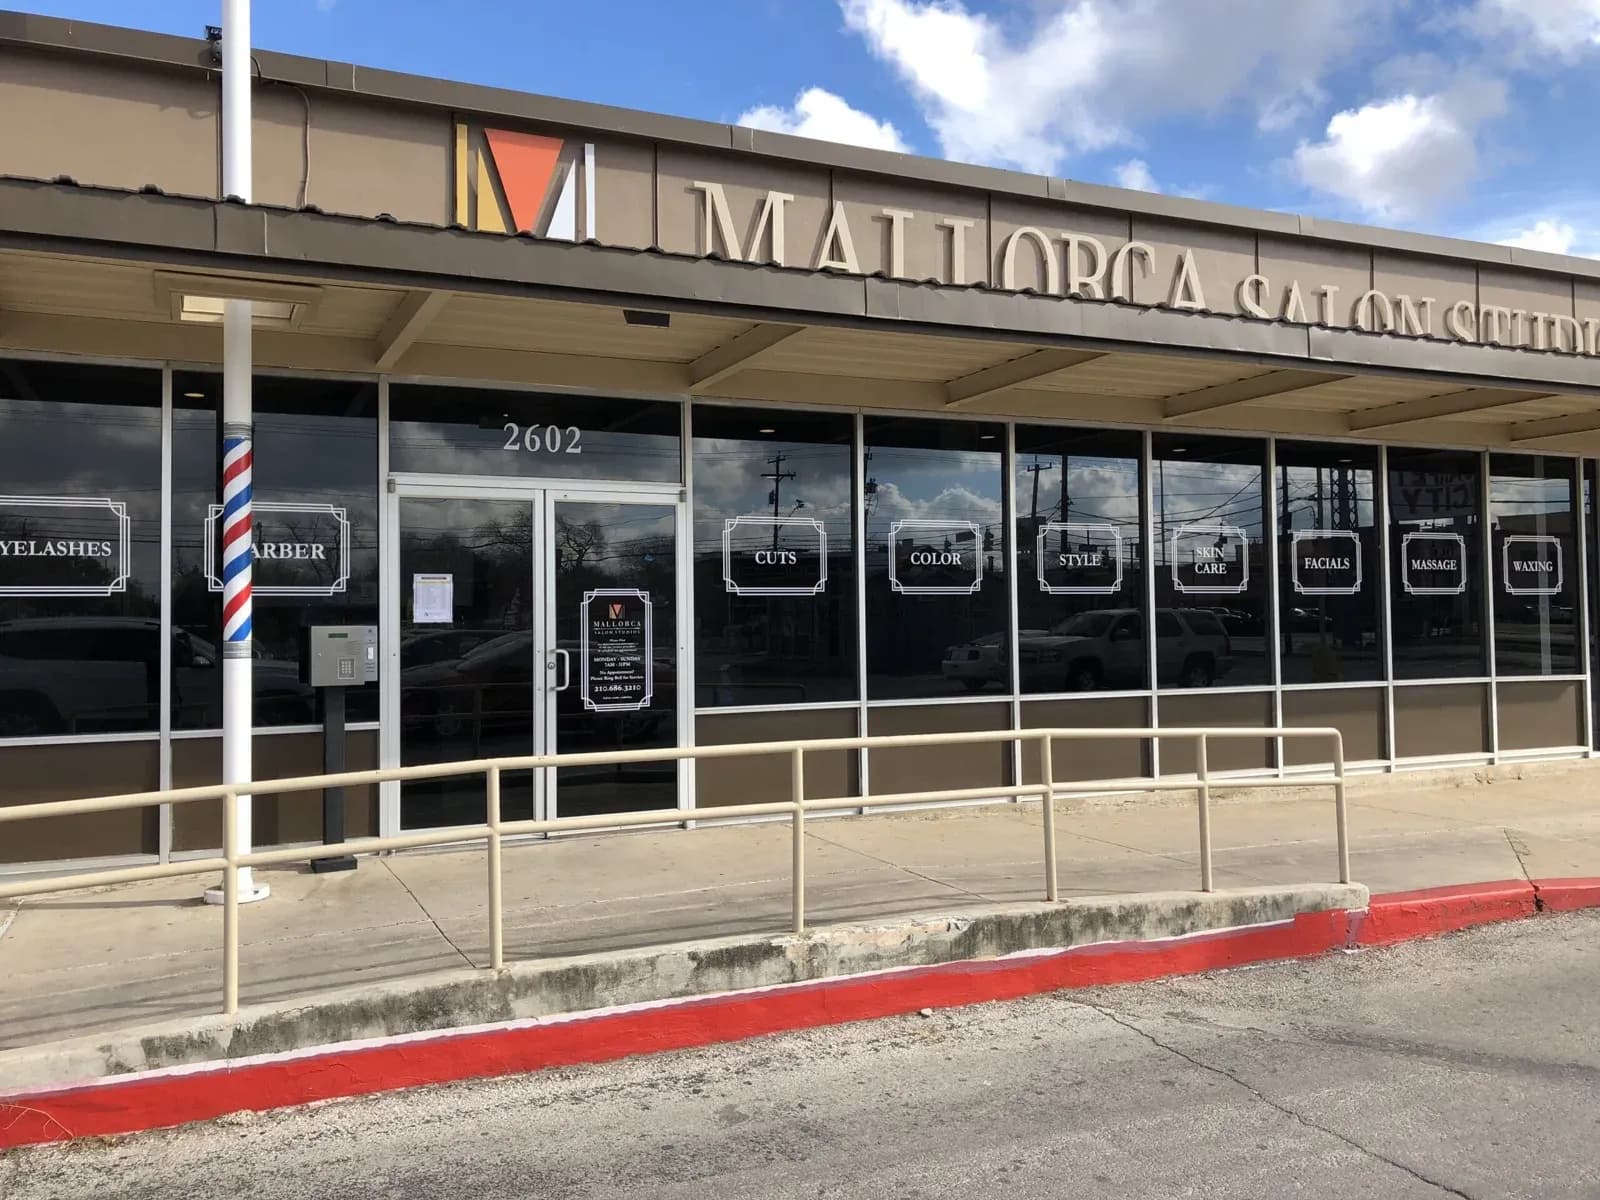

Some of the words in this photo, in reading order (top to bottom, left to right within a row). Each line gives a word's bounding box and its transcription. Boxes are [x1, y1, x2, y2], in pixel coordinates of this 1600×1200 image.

[503, 422, 582, 454] 2602
[250, 542, 326, 560] ARBER
[754, 550, 797, 566] CUTS
[1196, 546, 1226, 559] SKIN
[910, 551, 962, 567] COLOR
[1058, 553, 1102, 567] STYLE
[1303, 557, 1351, 571] FACIALS
[1411, 559, 1458, 571] MASSAGE
[1194, 562, 1228, 575] CARE
[1512, 560, 1554, 573] WAXING
